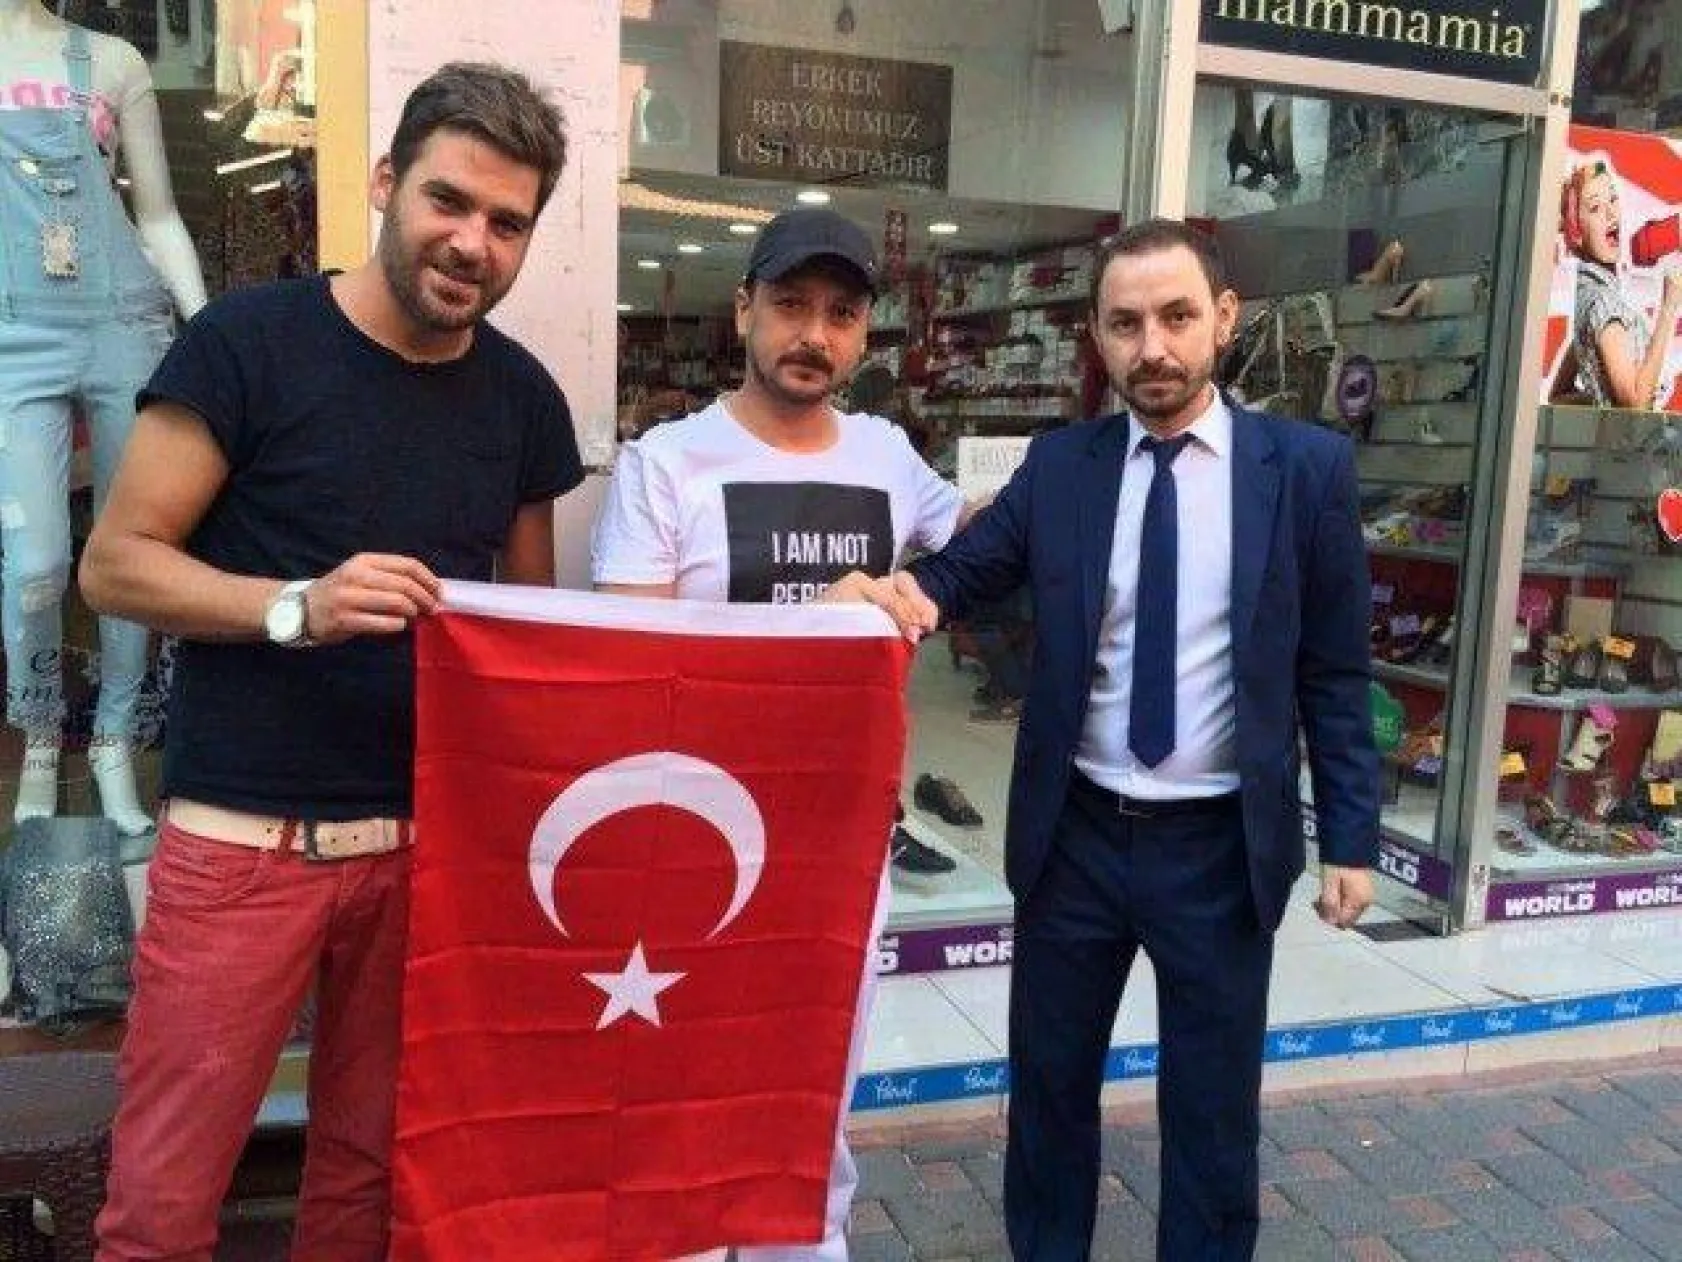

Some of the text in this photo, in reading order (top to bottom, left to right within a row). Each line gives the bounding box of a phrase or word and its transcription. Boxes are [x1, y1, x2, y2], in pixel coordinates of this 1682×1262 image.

[792, 62, 881, 98] ERKEK
[771, 532, 869, 566] I AM NOT
[1505, 893, 1595, 916] WORLD
[1615, 885, 1682, 908] WORL
[944, 941, 1014, 966] WOR
